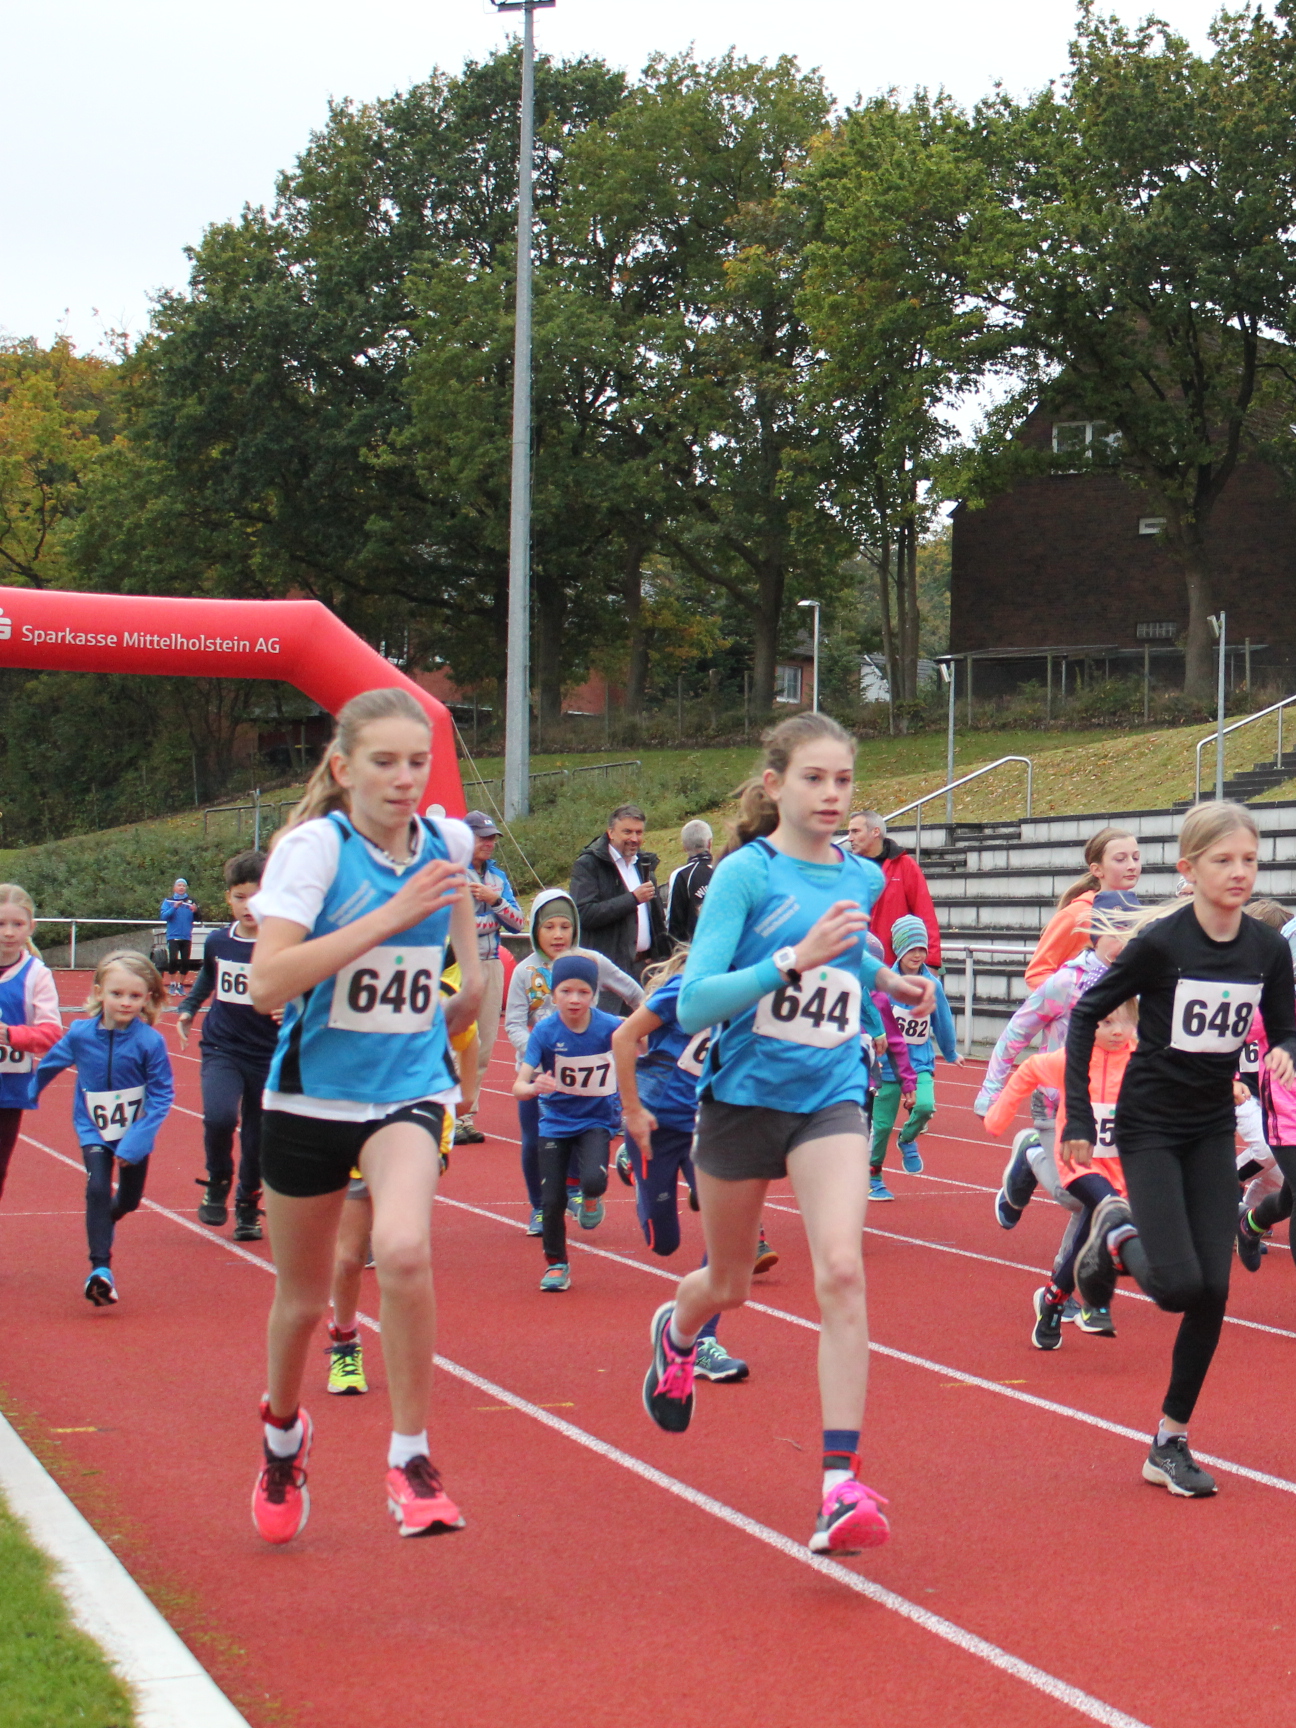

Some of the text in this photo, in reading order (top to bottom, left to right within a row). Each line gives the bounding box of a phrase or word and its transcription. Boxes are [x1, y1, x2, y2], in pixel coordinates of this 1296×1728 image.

[21, 625, 281, 654] Sparkasse Mittelholstein AG
[221, 971, 249, 995] 66
[348, 968, 432, 1014] 646
[771, 982, 850, 1033] 644
[1182, 999, 1254, 1038] 648
[560, 1062, 611, 1089] 677
[93, 1098, 144, 1132] 647
